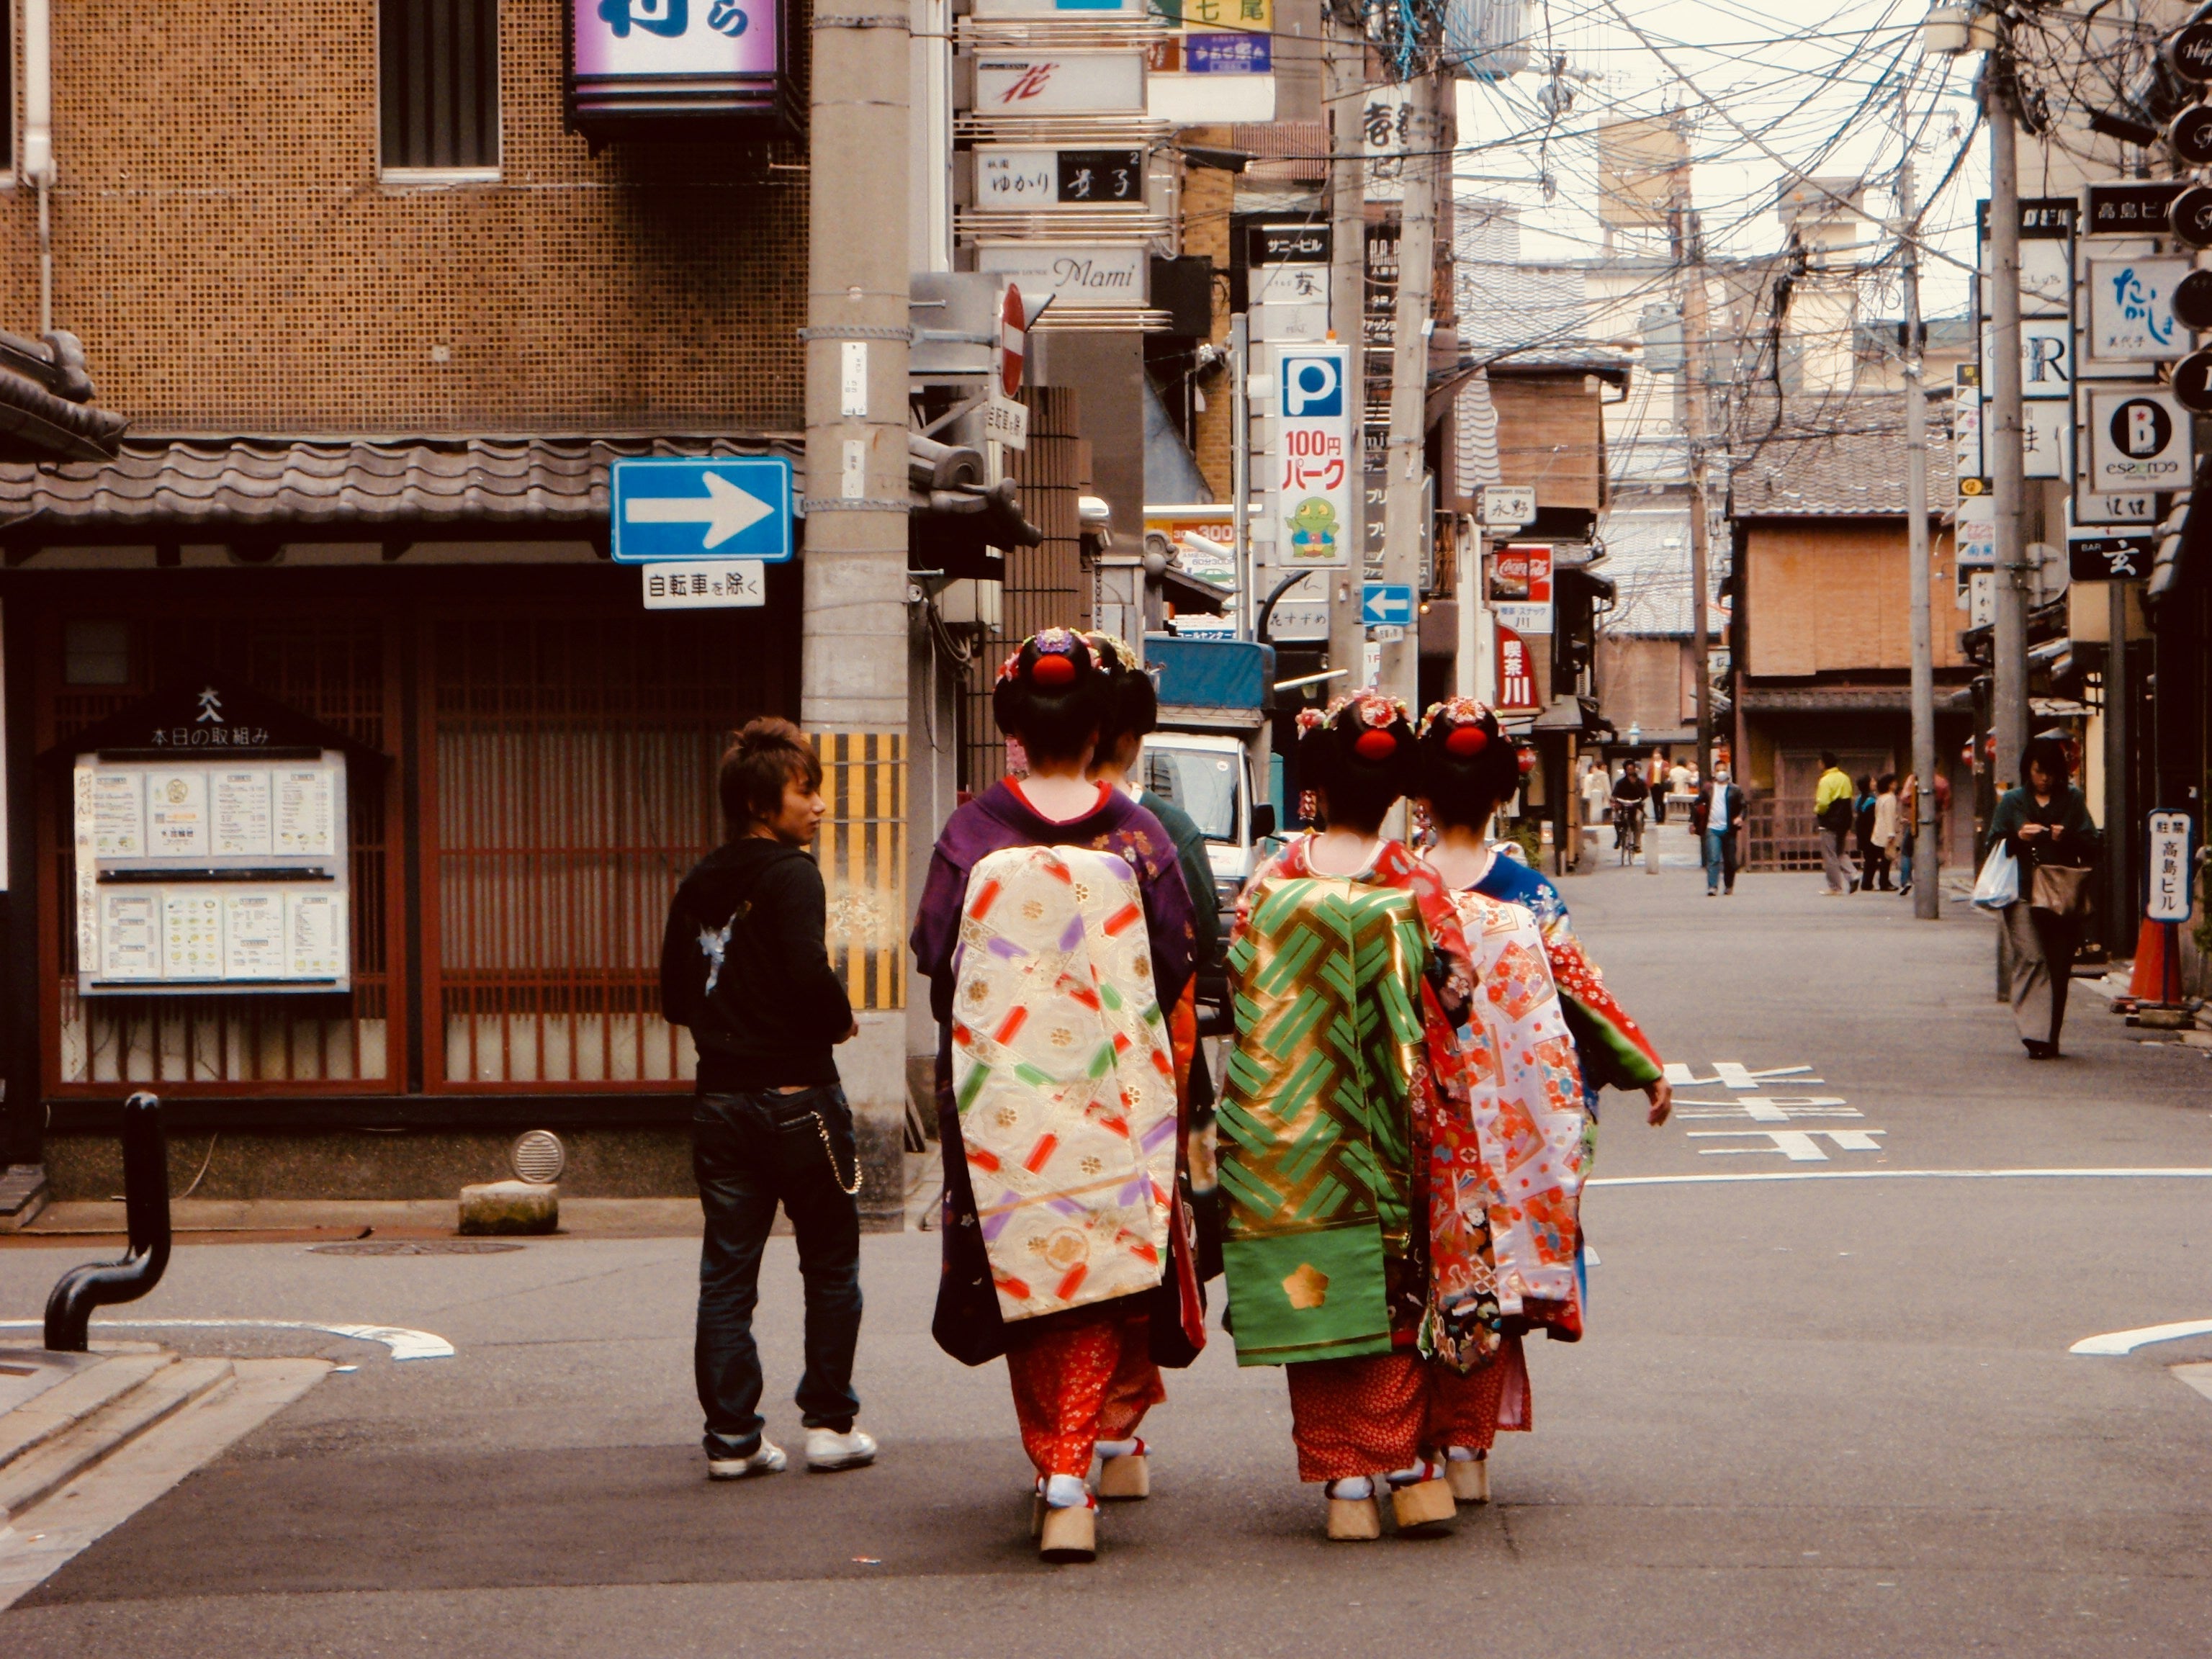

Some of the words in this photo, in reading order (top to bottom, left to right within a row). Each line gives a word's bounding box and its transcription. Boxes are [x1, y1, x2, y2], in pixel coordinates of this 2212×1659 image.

[993, 62, 1060, 103] 花
[1129, 152, 1139, 164] 2
[992, 172, 1049, 194] ゆかり
[1267, 238, 1323, 253] サニービル
[1053, 258, 1136, 288] Mami
[1285, 429, 1341, 457] 100円
[1282, 459, 1344, 491] パーク
[2081, 542, 2102, 552] BAR
[2102, 539, 2140, 576] 玄
[649, 572, 758, 598] 自転車を除く
[1269, 612, 1326, 626] 花すずめ
[1515, 616, 1531, 629] 川
[150, 726, 270, 746] 本日の取組み
[2160, 840, 2178, 912] 高島ビル
